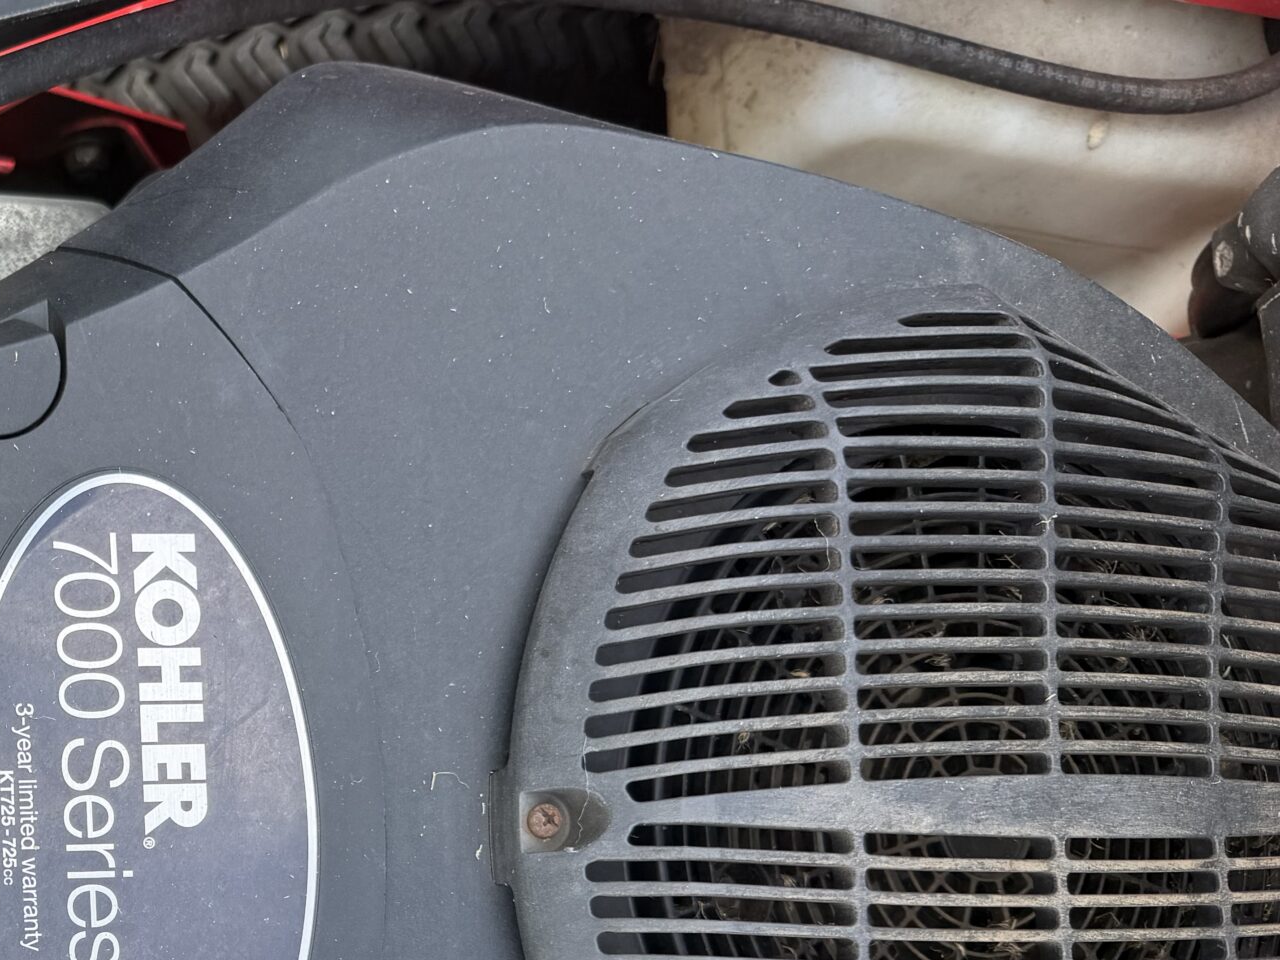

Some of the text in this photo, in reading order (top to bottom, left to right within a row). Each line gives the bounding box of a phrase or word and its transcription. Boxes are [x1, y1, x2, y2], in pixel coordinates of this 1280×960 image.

[52, 532, 125, 719] 7000
[11, 702, 43, 952] 3-year limited warranty
